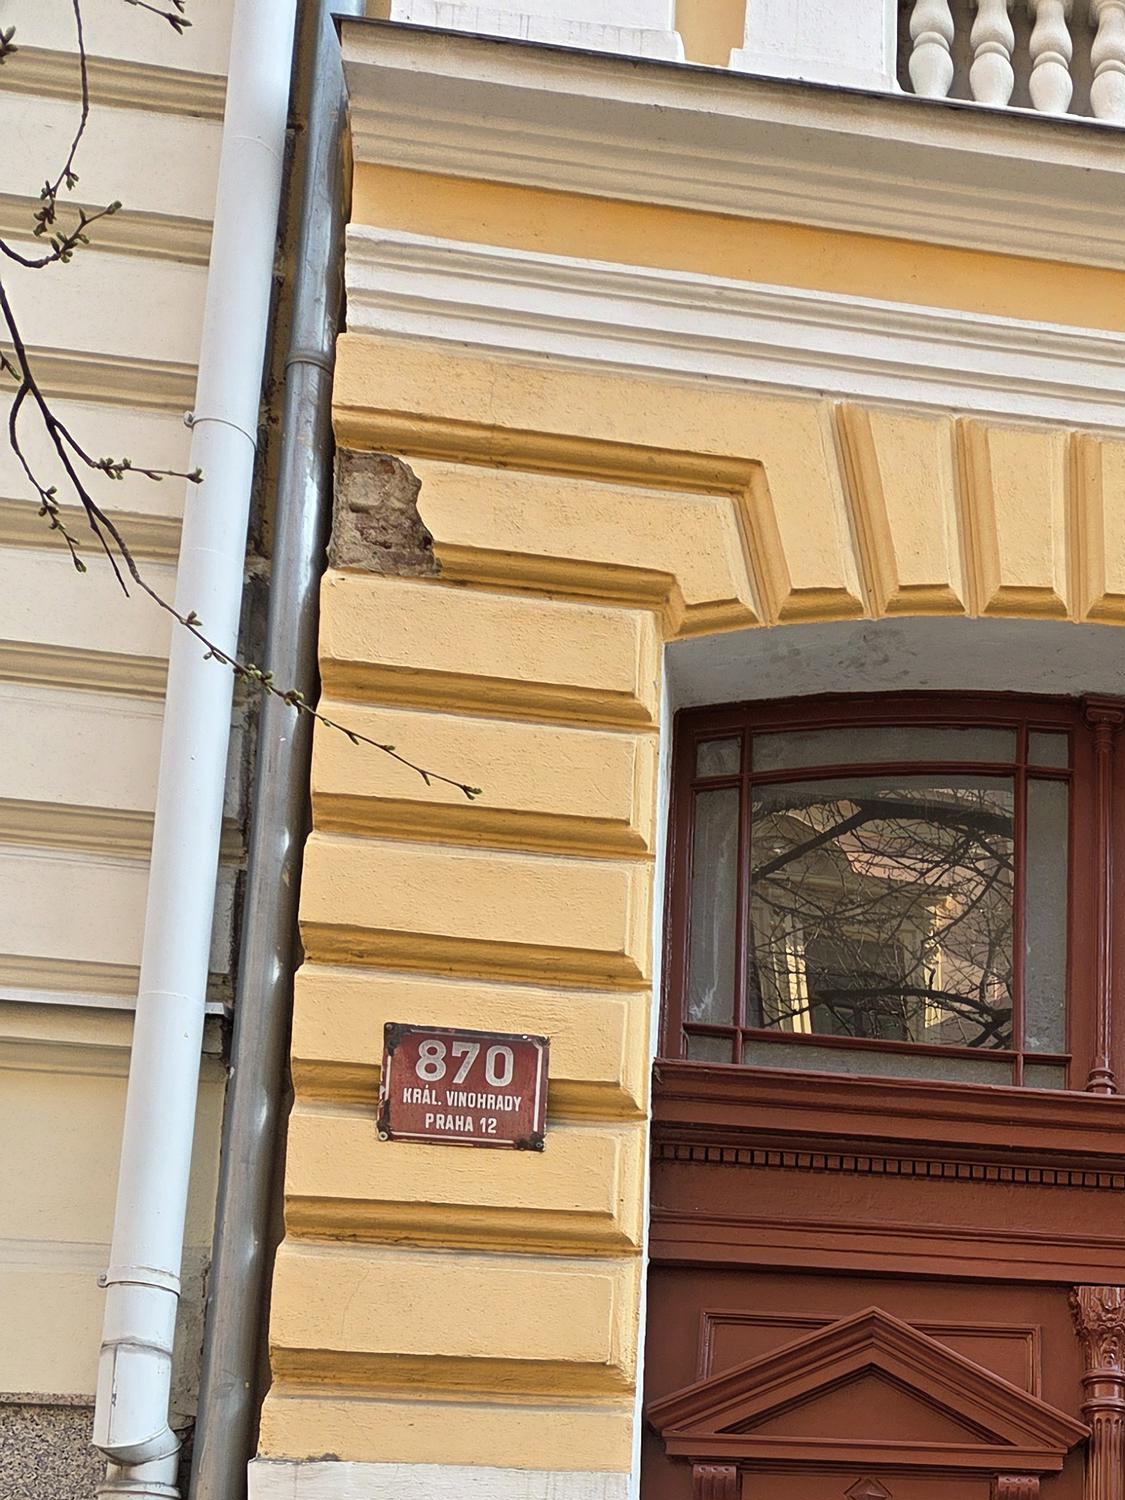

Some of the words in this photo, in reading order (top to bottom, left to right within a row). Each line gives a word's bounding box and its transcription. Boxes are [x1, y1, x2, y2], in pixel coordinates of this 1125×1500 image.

[415, 1039, 514, 1087] 870
[403, 1085, 442, 1106] KRÁL.
[446, 1090, 522, 1112] VINOHRADY
[425, 1113, 474, 1132] PRAHA
[479, 1117, 497, 1134] 12
